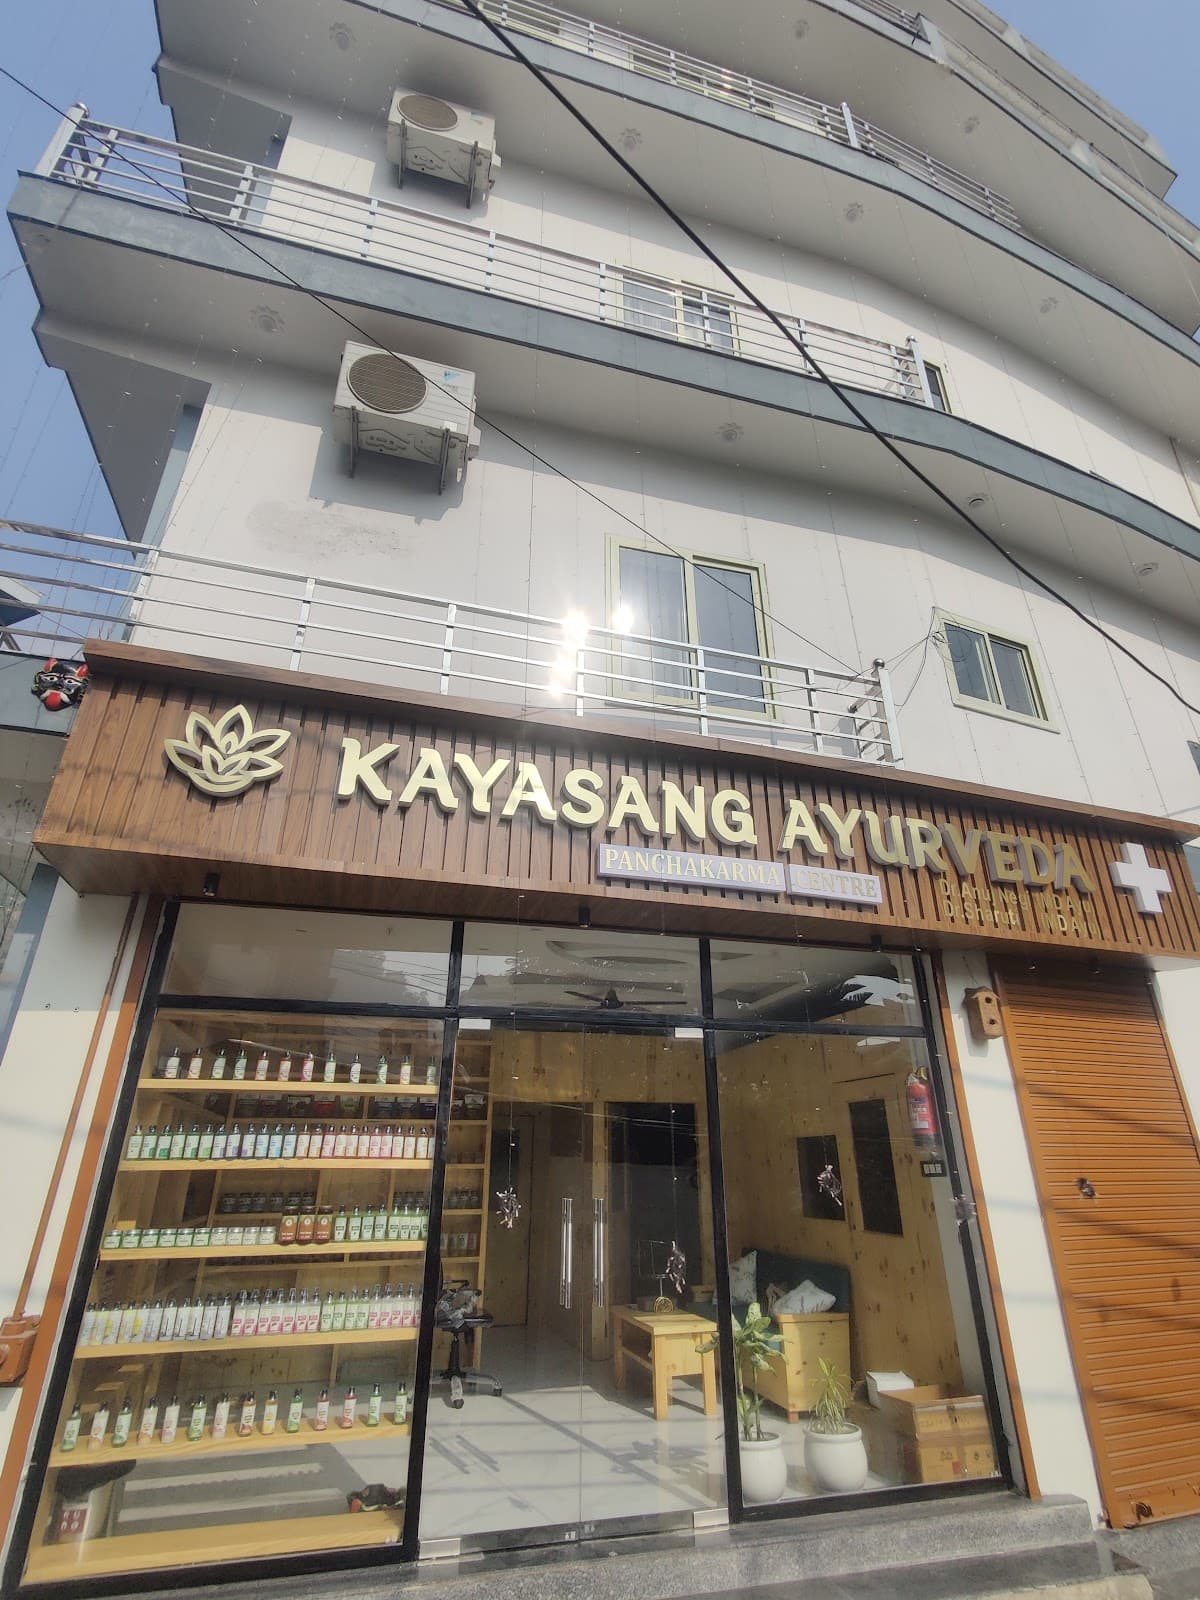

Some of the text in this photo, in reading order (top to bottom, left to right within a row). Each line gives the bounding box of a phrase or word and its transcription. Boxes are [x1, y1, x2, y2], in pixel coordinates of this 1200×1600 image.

[337, 737, 1095, 892] KAYASANG AYURVEDA
[604, 848, 878, 898] PANCHAKARMA CENTRE
